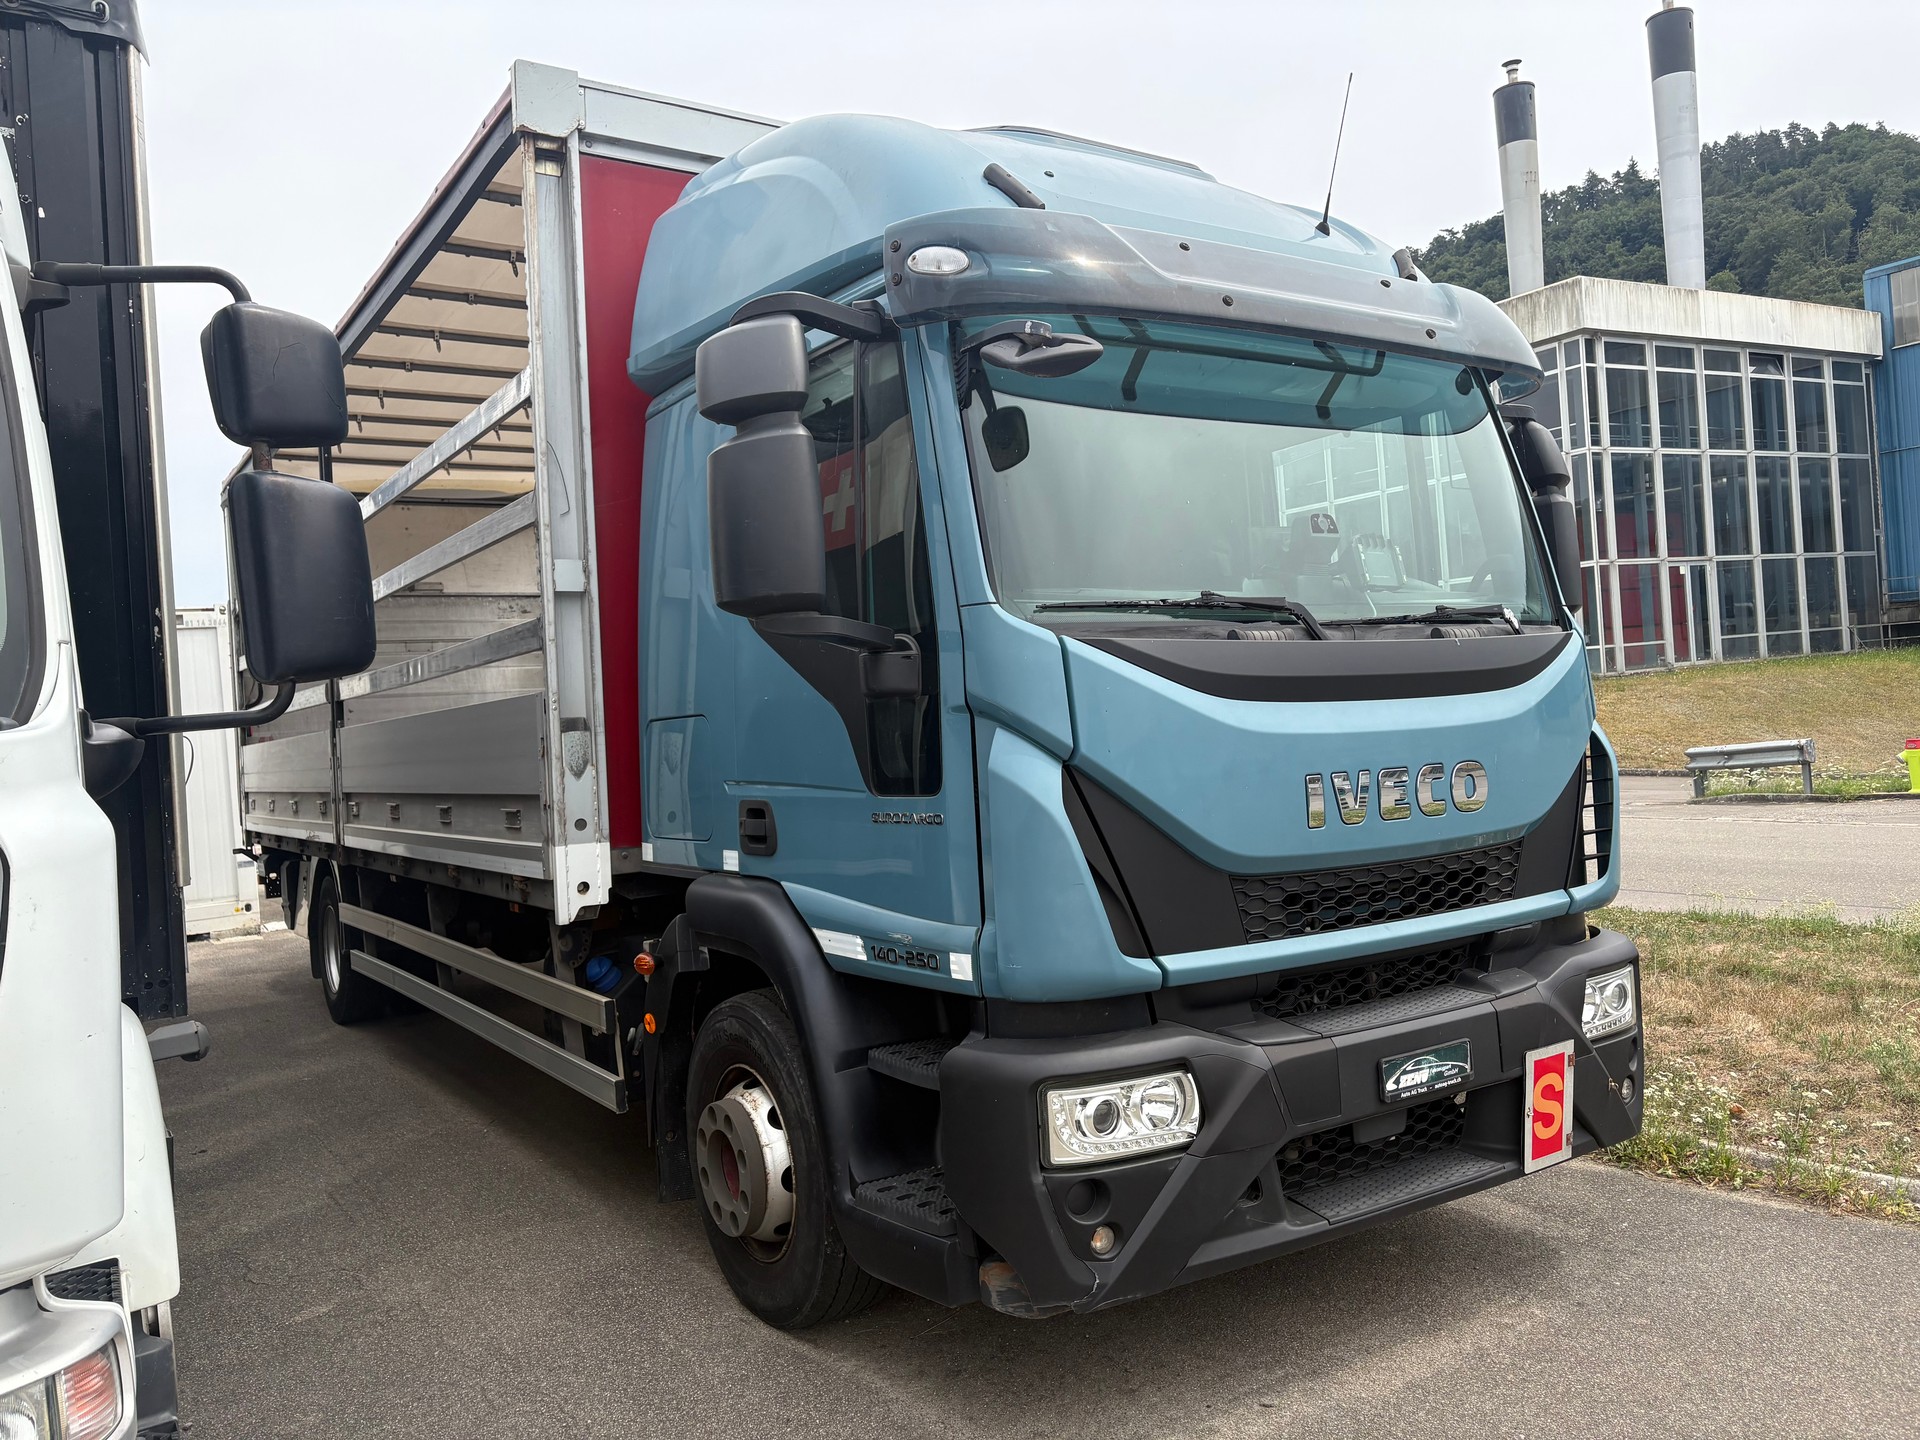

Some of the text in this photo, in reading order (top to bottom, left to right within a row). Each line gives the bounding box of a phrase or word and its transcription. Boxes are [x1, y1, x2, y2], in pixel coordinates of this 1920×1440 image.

[1304, 759, 1489, 831] IVECO
[871, 811, 945, 826] EUROCARGO
[870, 944, 941, 971] 140-250
[1418, 1086, 1428, 1094] Truck
[1533, 1072, 1564, 1140] S
